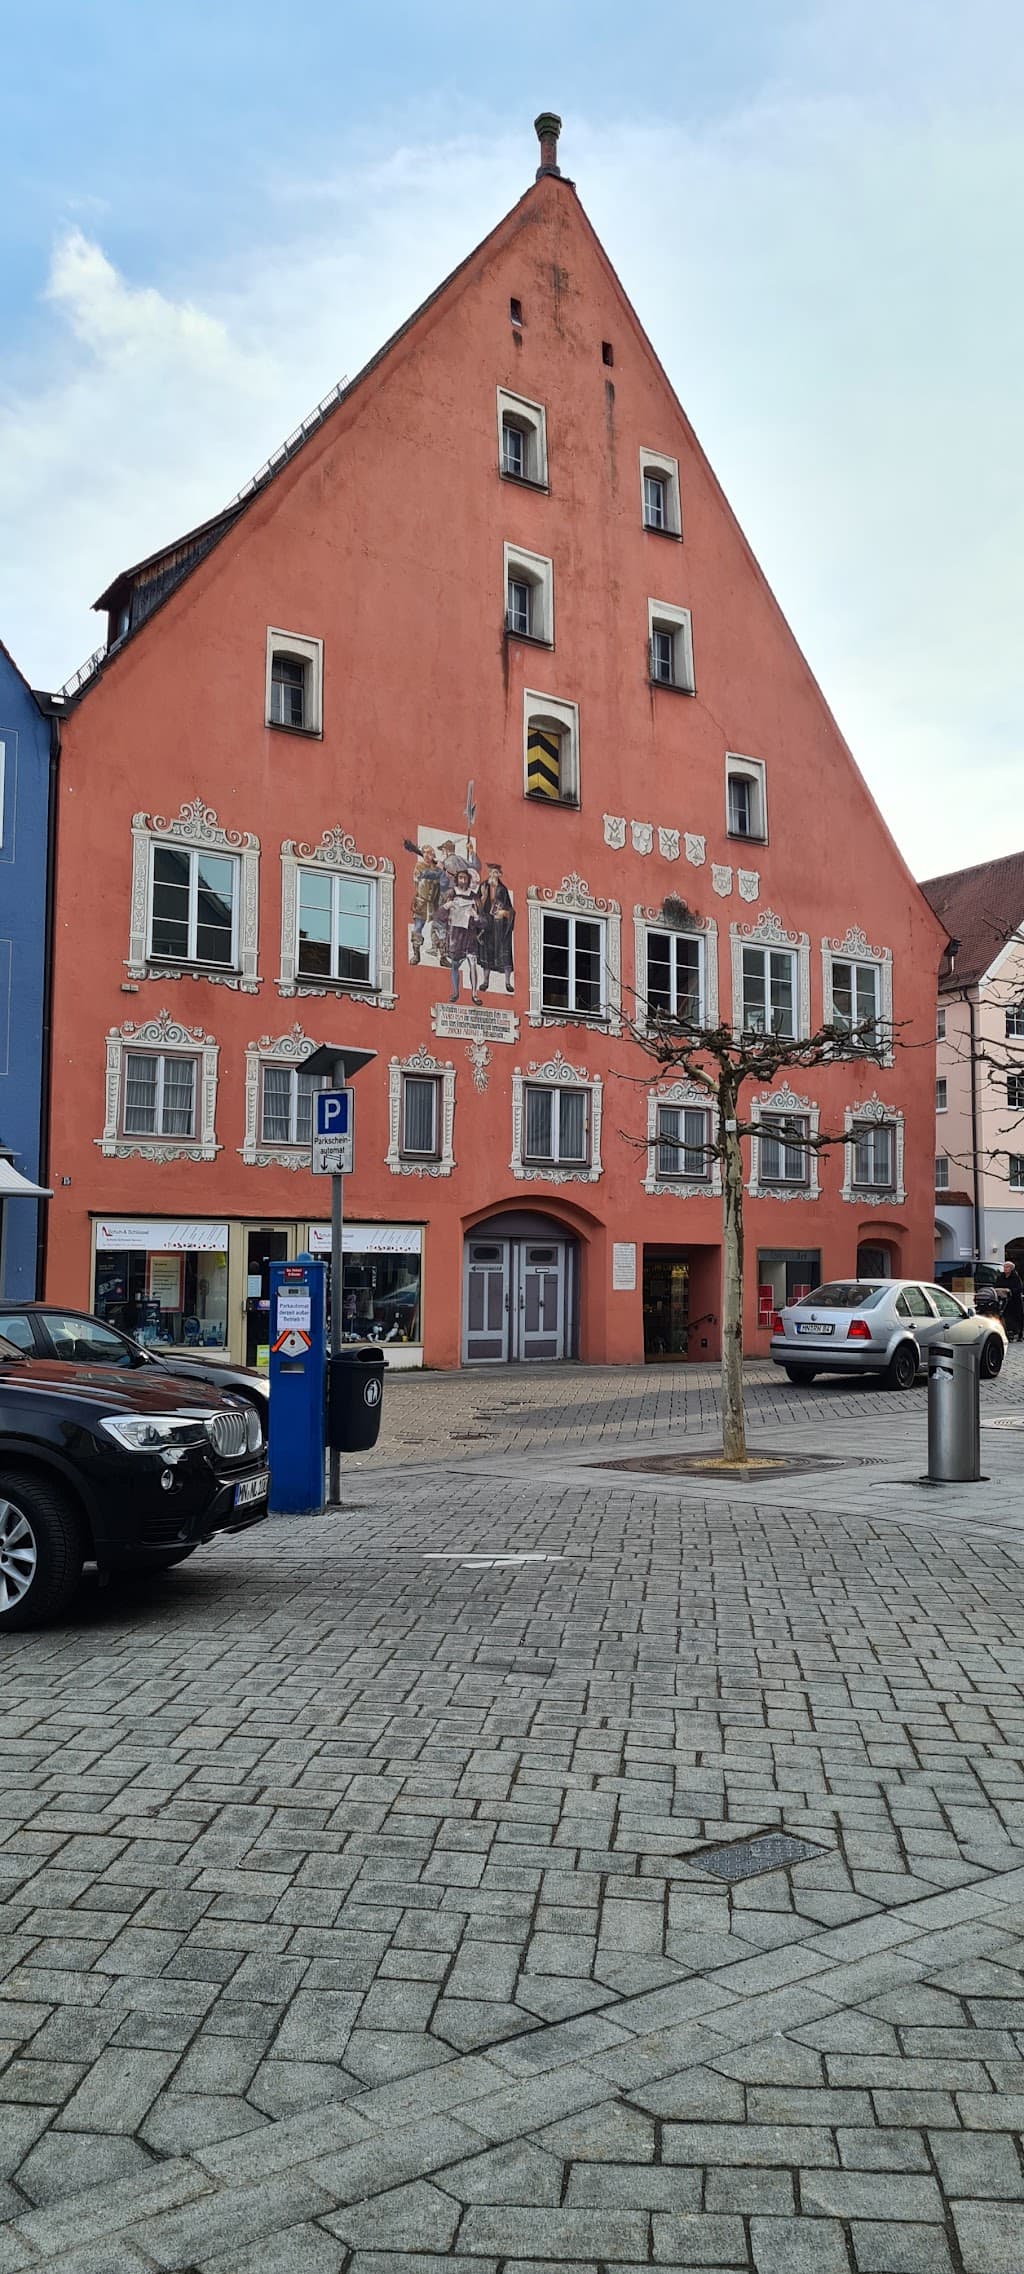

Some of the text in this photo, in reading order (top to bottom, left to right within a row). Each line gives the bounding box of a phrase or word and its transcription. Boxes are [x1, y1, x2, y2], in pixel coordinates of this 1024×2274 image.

[324, 1099, 341, 1129] P
[314, 1136, 351, 1145] Parkschein-
[320, 1146, 345, 1154] automat
